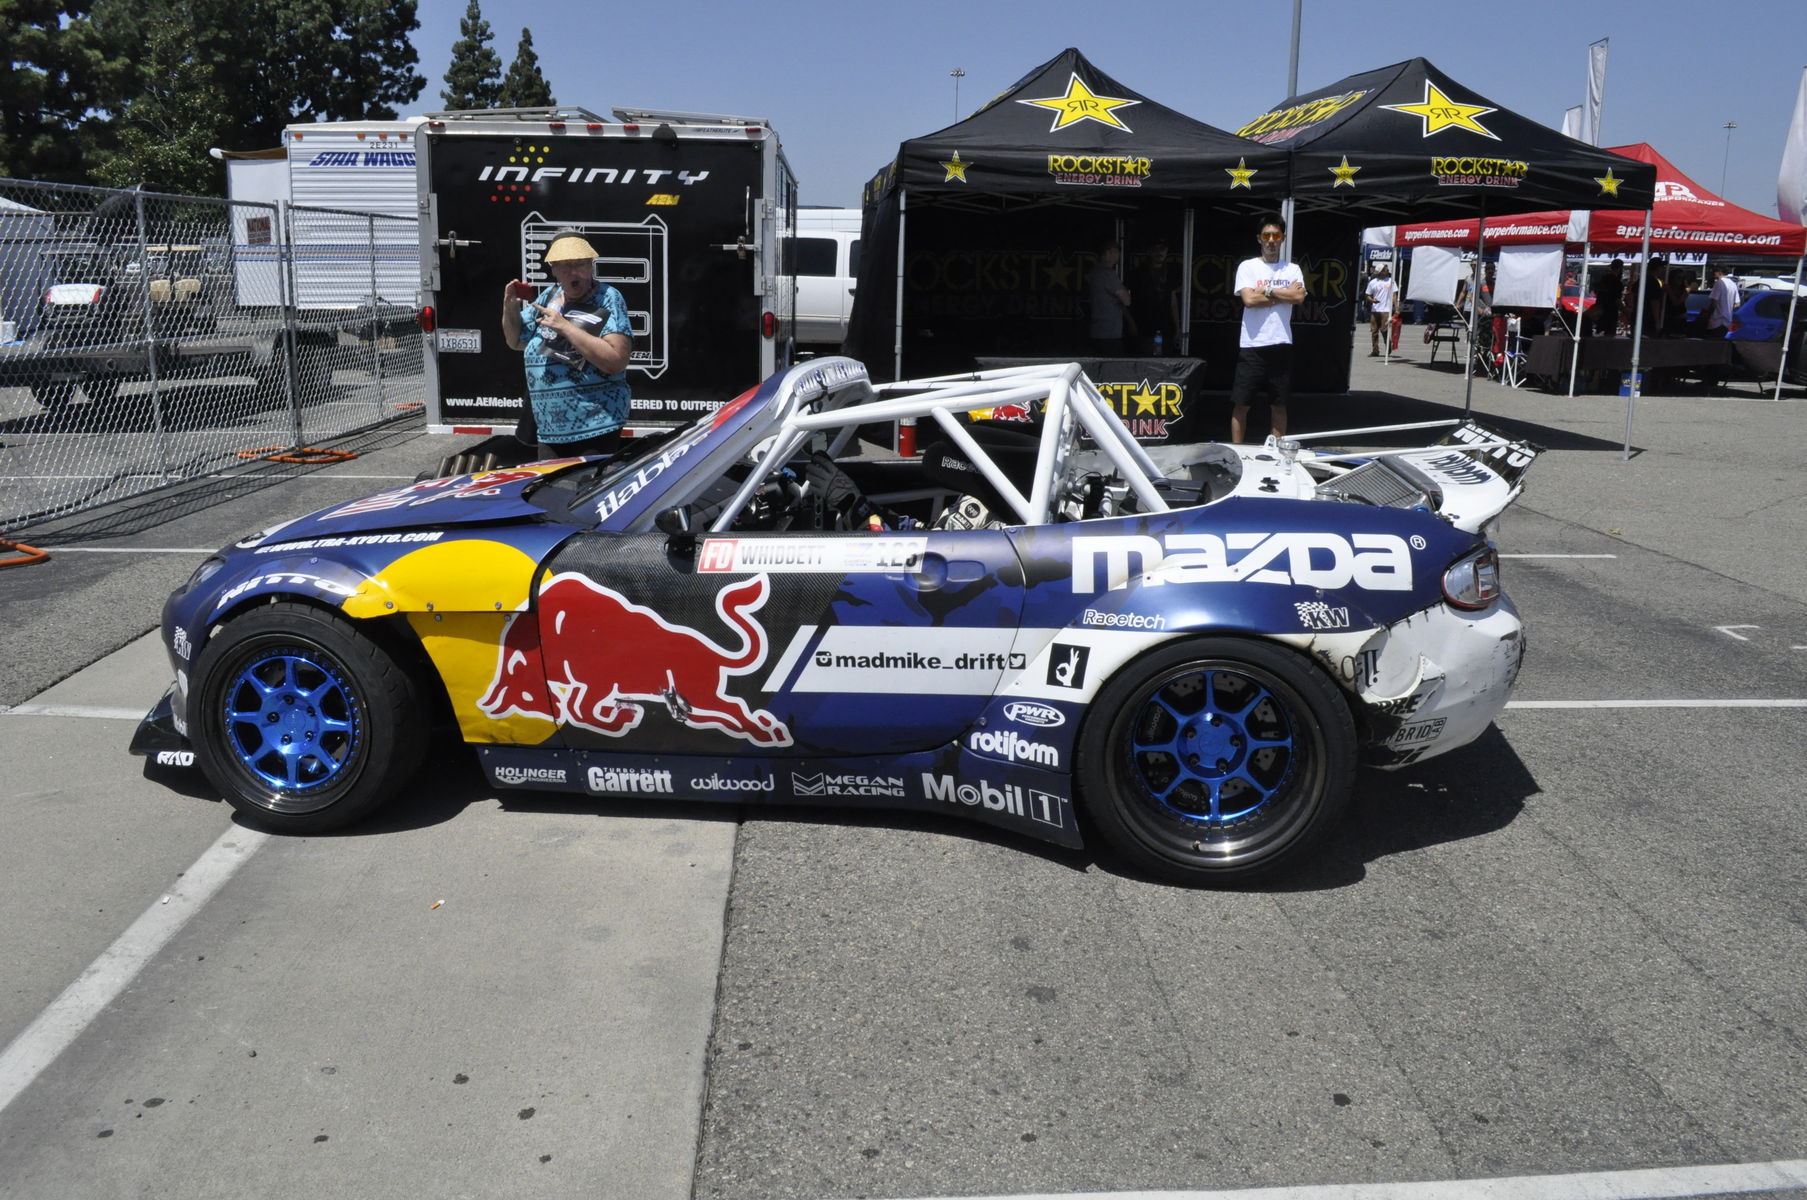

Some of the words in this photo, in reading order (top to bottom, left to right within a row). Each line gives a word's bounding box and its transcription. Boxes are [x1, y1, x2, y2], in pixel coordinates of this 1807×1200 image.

[309, 152, 360, 166] STAR
[363, 152, 416, 166] WAGG
[1049, 155, 1151, 175] ROCKSTAR
[1433, 157, 1529, 176] ROCKSTAR
[478, 166, 710, 185] INFINITY
[1056, 173, 1101, 183] ENERGY
[1106, 175, 1141, 185] DRINK
[1440, 175, 1481, 184] ENERGY
[1486, 176, 1518, 186] DRINK
[1654, 196, 1725, 206] ERFORMANCE
[1404, 228, 1469, 241] aprperformance.com
[446, 396, 523, 408] www.AEMelect
[631, 399, 663, 410] EERED
[665, 400, 678, 410] TO
[681, 400, 730, 411] OUTPERF
[702, 542, 733, 570] FD
[216, 572, 357, 610] NITTO
[1083, 609, 1166, 630] Racetech
[1308, 607, 1349, 628] KW
[836, 652, 1005, 670] madmike_drift
[1010, 704, 1059, 721] PWR
[1395, 725, 1432, 742] BRID
[970, 730, 1059, 767] rotiform
[495, 766, 567, 779] HOLINGER
[587, 766, 674, 793] Garrett
[825, 774, 904, 787] MEGAN
[691, 773, 775, 791] wilwood
[825, 785, 905, 797] RACING
[922, 772, 1025, 817] Mobil
